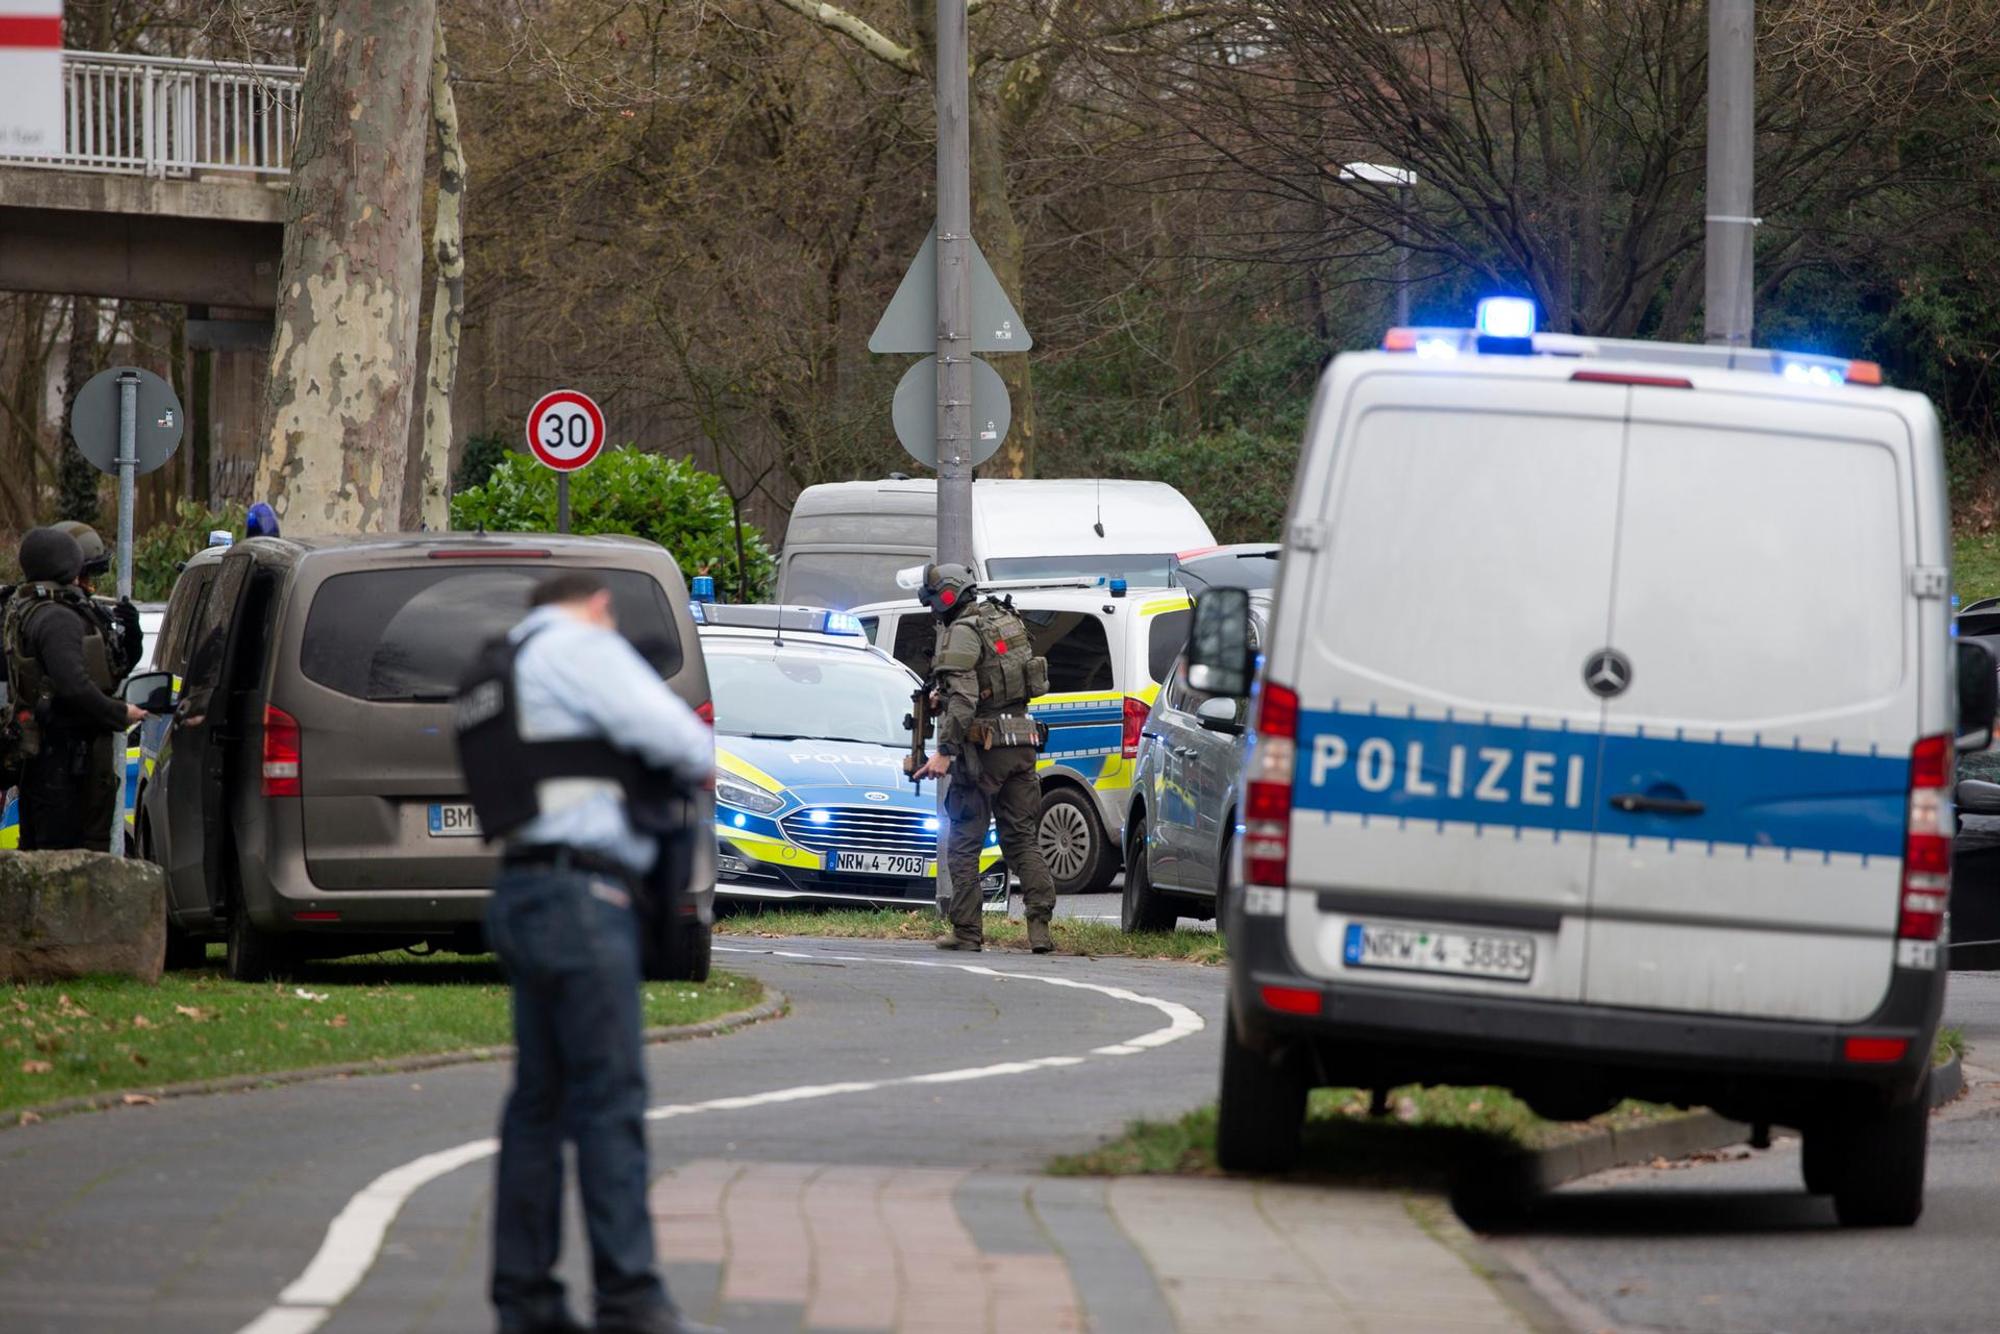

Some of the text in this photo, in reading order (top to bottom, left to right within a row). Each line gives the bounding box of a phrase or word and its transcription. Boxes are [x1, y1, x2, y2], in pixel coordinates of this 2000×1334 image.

[545, 413, 587, 448] 30
[788, 753, 905, 769] POLIZ
[1310, 733, 1584, 808] POLIZEI
[443, 807, 472, 828] BM
[836, 853, 864, 870] NRW
[1363, 929, 1413, 958] NRW
